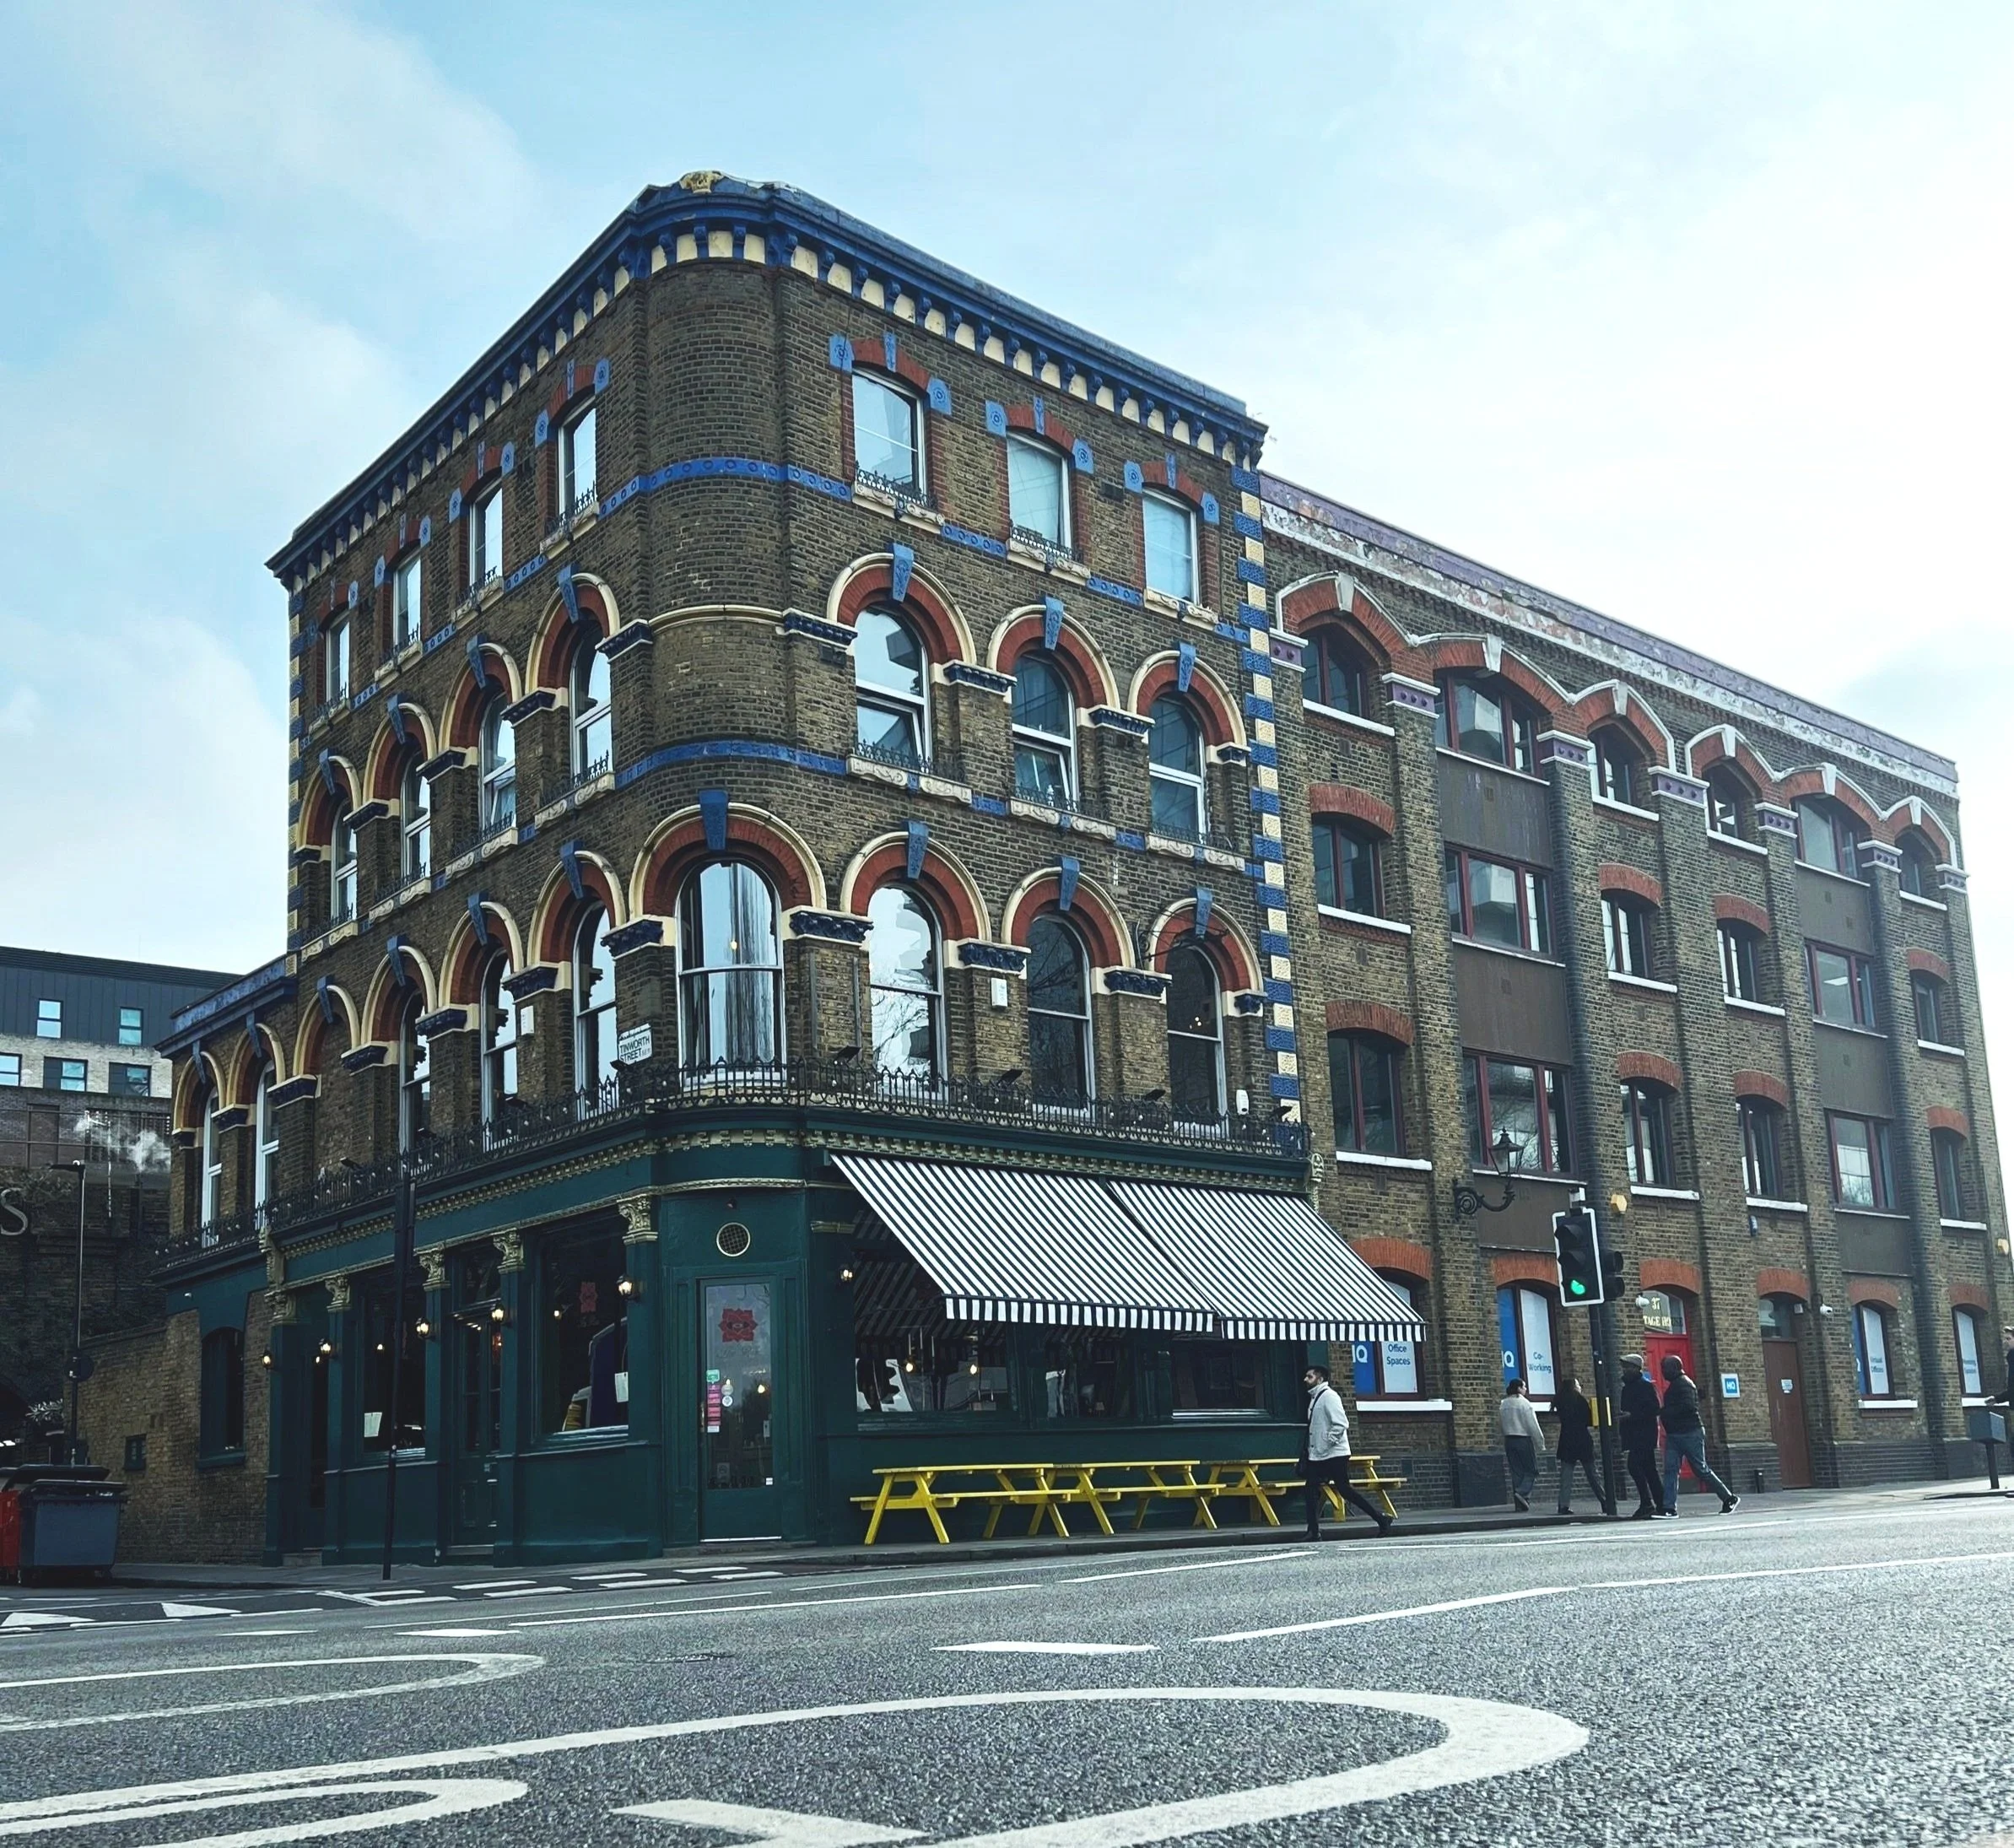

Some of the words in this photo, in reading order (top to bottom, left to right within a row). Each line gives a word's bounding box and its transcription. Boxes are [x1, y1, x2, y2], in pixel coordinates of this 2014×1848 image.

[620, 1036, 651, 1054] TINWORTH
[620, 1048, 641, 1062] STREET
[1651, 1297, 1660, 1310] 37
[1388, 1343, 1407, 1354] Office
[1386, 1356, 1411, 1367] Spaces
[1528, 1363, 1552, 1374] Working
[1726, 1381, 1736, 1391] HQ
